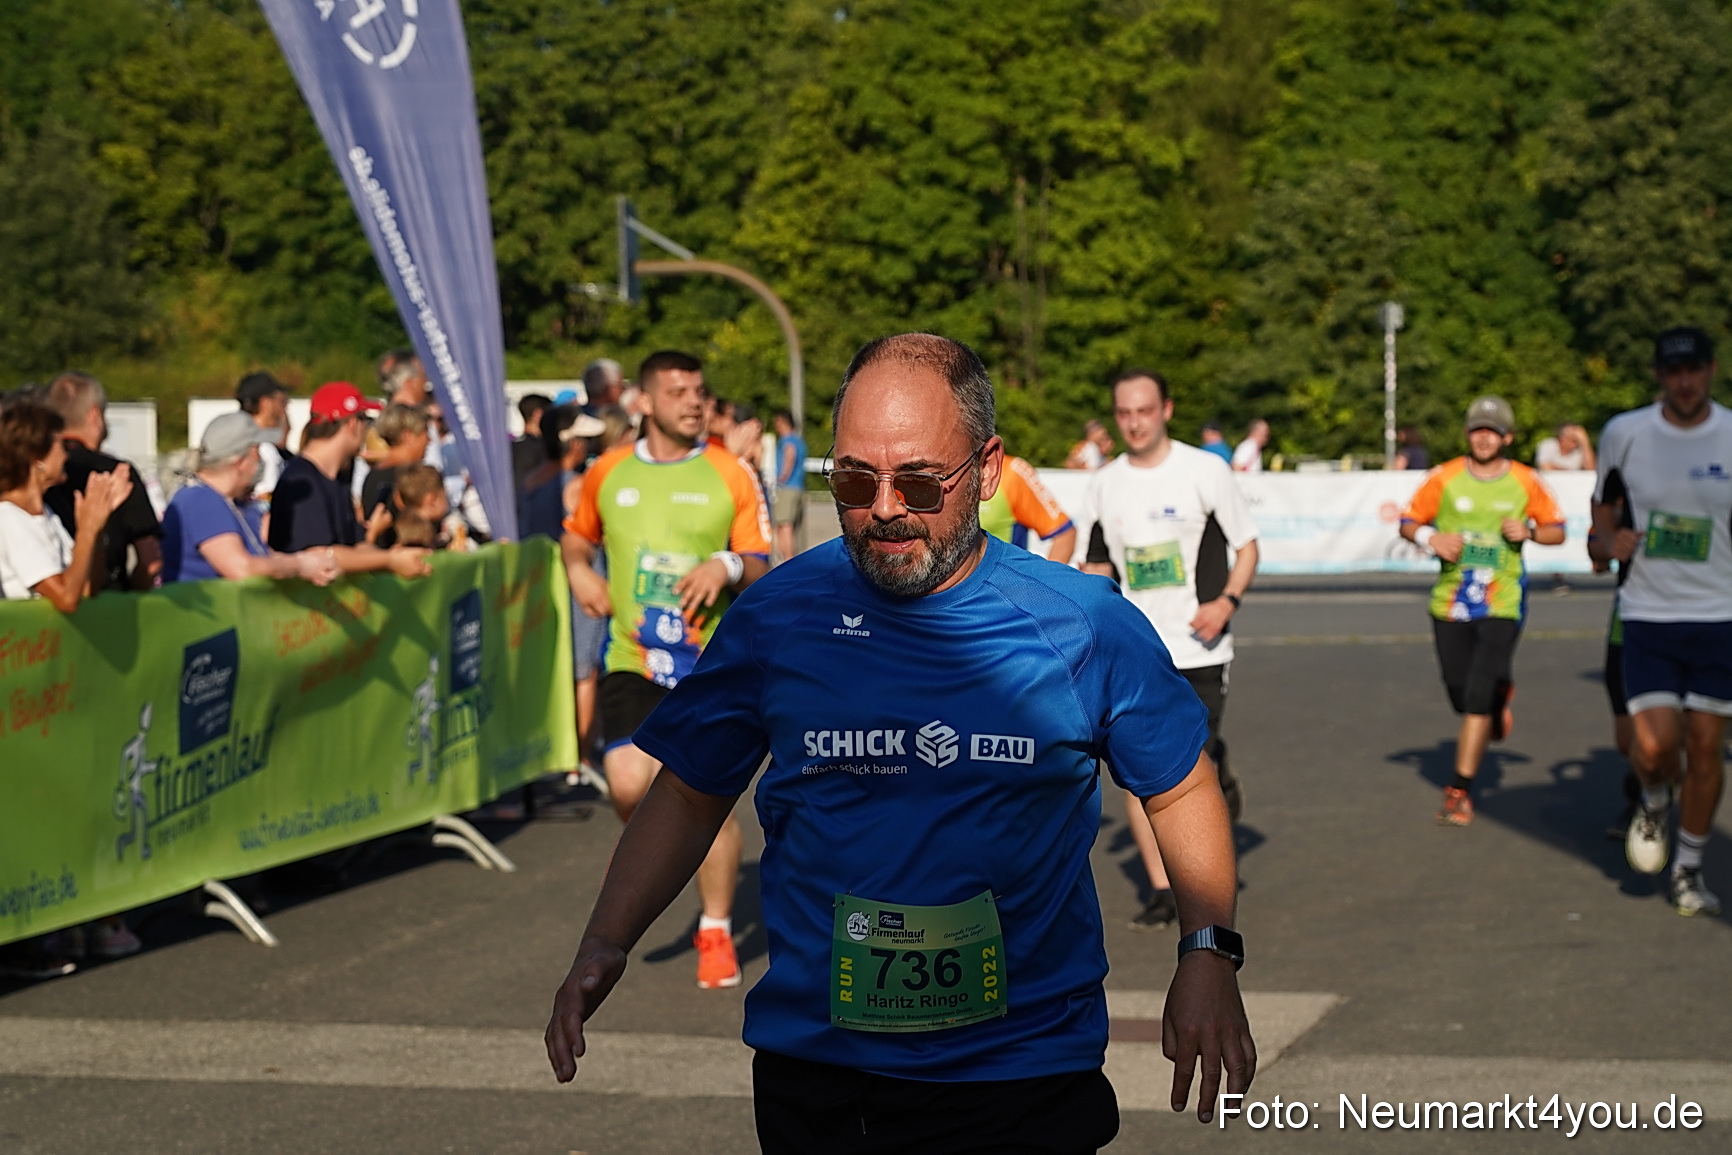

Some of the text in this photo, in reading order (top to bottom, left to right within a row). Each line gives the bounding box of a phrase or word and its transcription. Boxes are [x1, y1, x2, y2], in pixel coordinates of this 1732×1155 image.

[832, 626, 871, 638] erima
[803, 729, 1030, 761] SCHICK BAU
[801, 763, 908, 776] einfach schick bauen
[871, 927, 926, 939] Firmenlauf
[891, 937, 925, 945] neumarkt
[871, 948, 963, 991] 736
[981, 945, 1000, 1003] 2022
[839, 956, 853, 1003] RUN
[866, 992, 969, 1009] Haritz Ringo
